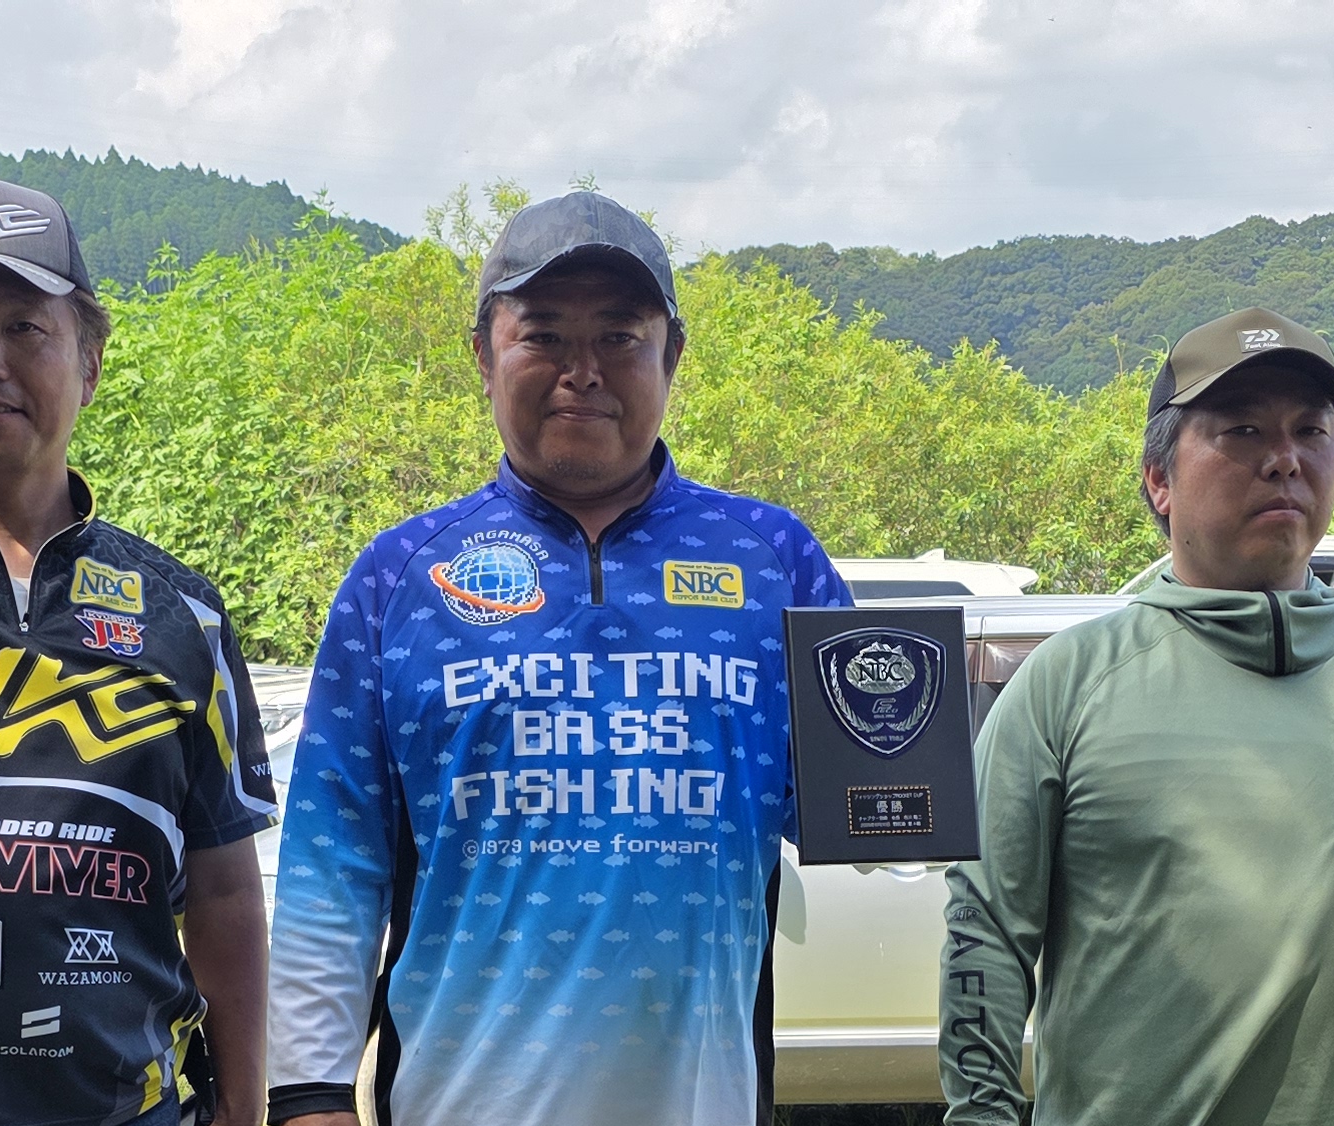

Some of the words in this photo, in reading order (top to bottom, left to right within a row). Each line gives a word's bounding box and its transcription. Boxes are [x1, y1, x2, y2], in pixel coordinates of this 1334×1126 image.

[461, 529, 549, 561] NAGAMASA
[76, 567, 137, 602] NBC
[670, 569, 737, 596] NBC
[82, 619, 142, 650] JB
[855, 662, 905, 682] NBC
[876, 800, 904, 813] 優勝
[58, 822, 117, 844] RIDE
[38, 971, 133, 985] WAZAMONO
[948, 929, 1005, 1107] AFTCO
[0, 1045, 74, 1058] SOLAROAM
